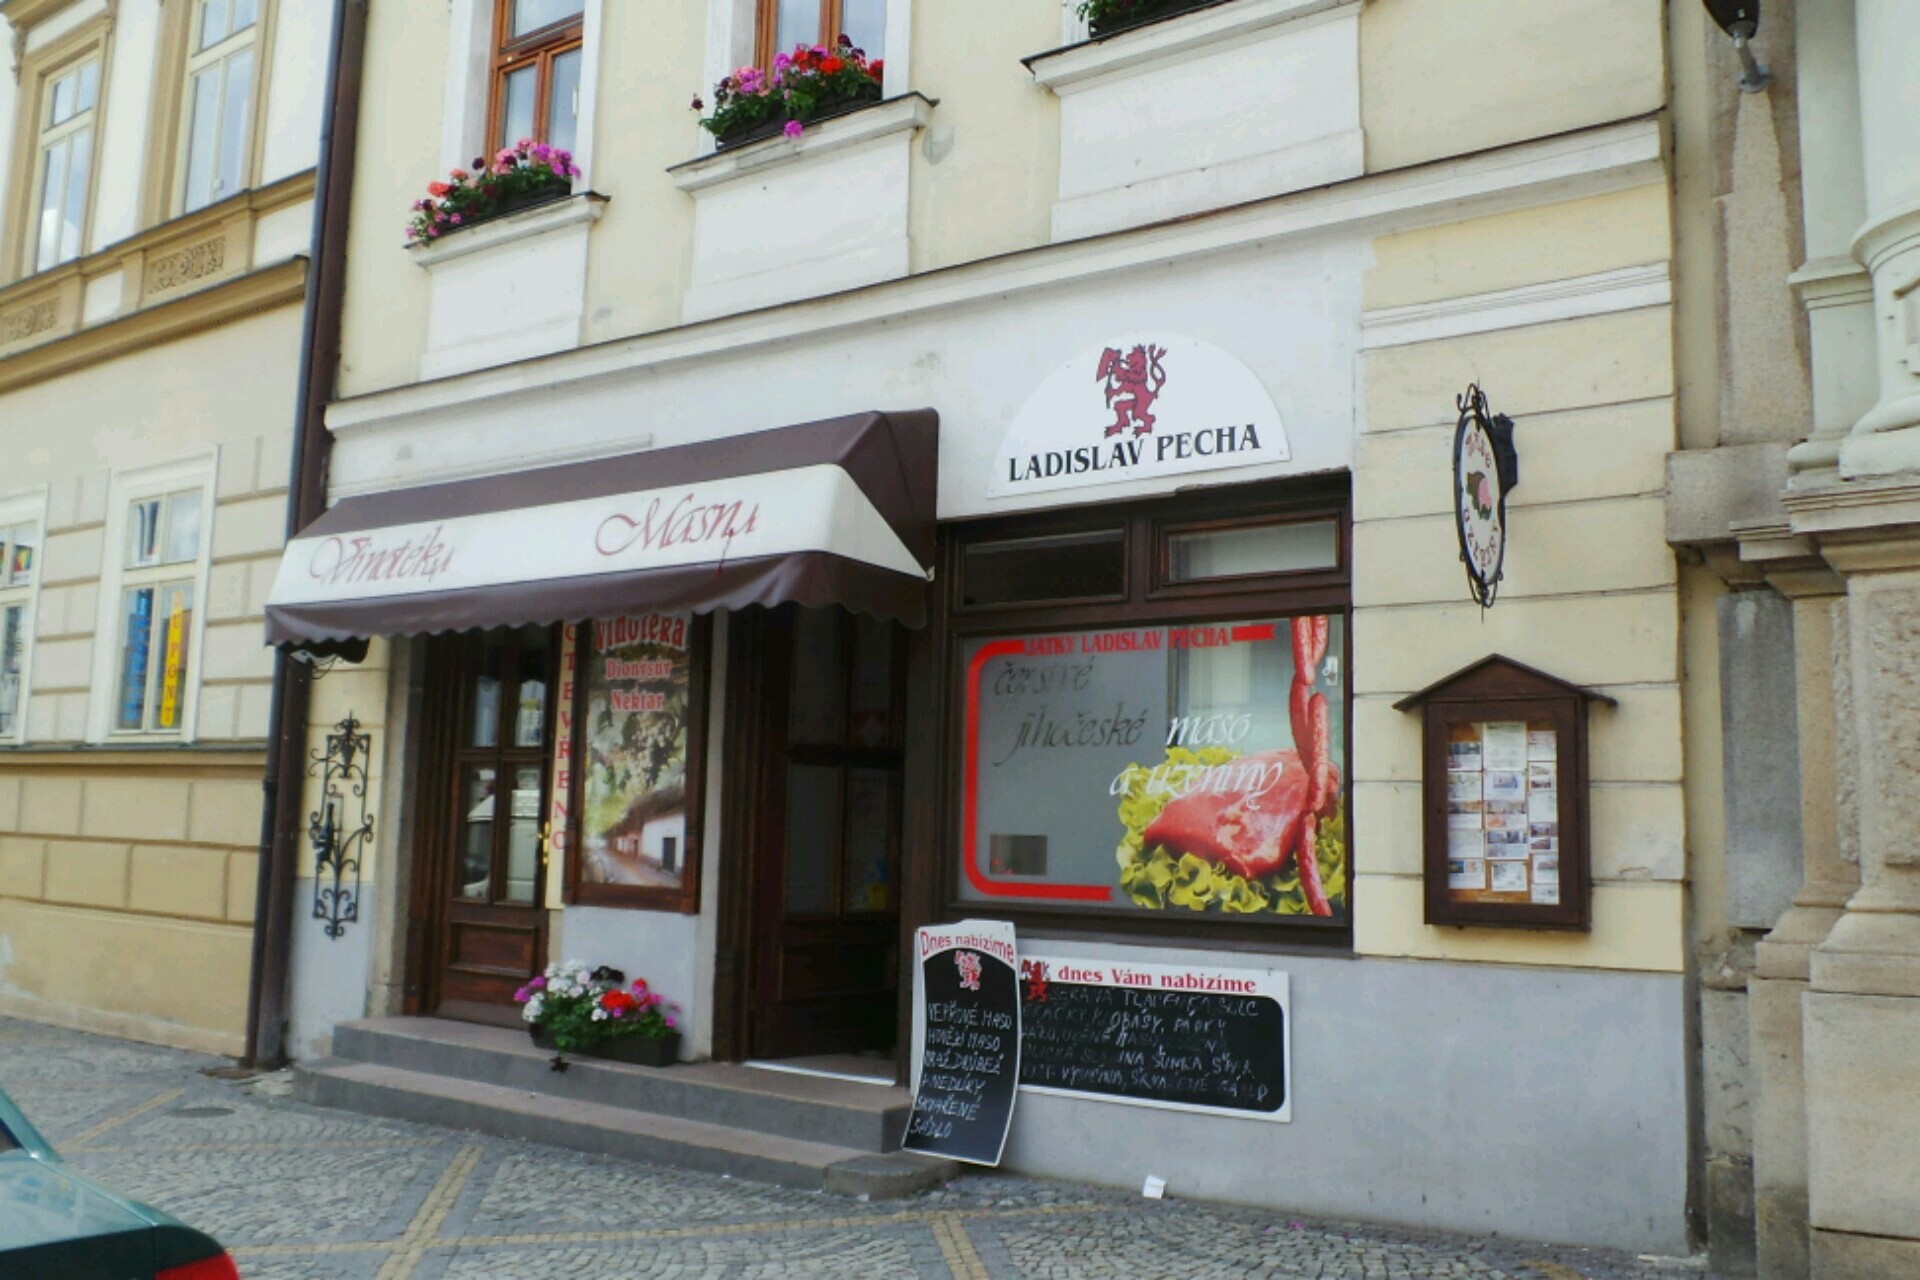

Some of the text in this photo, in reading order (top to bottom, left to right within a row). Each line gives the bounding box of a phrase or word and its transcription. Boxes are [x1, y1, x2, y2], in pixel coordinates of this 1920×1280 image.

[1008, 423, 1261, 482] LADISLAV PECHA
[1081, 631, 1162, 653] LADISLAV
[1165, 713, 1252, 746] maso
[920, 930, 953, 956] Dnes
[1058, 966, 1103, 982] dnes
[1111, 968, 1152, 987] Vám
